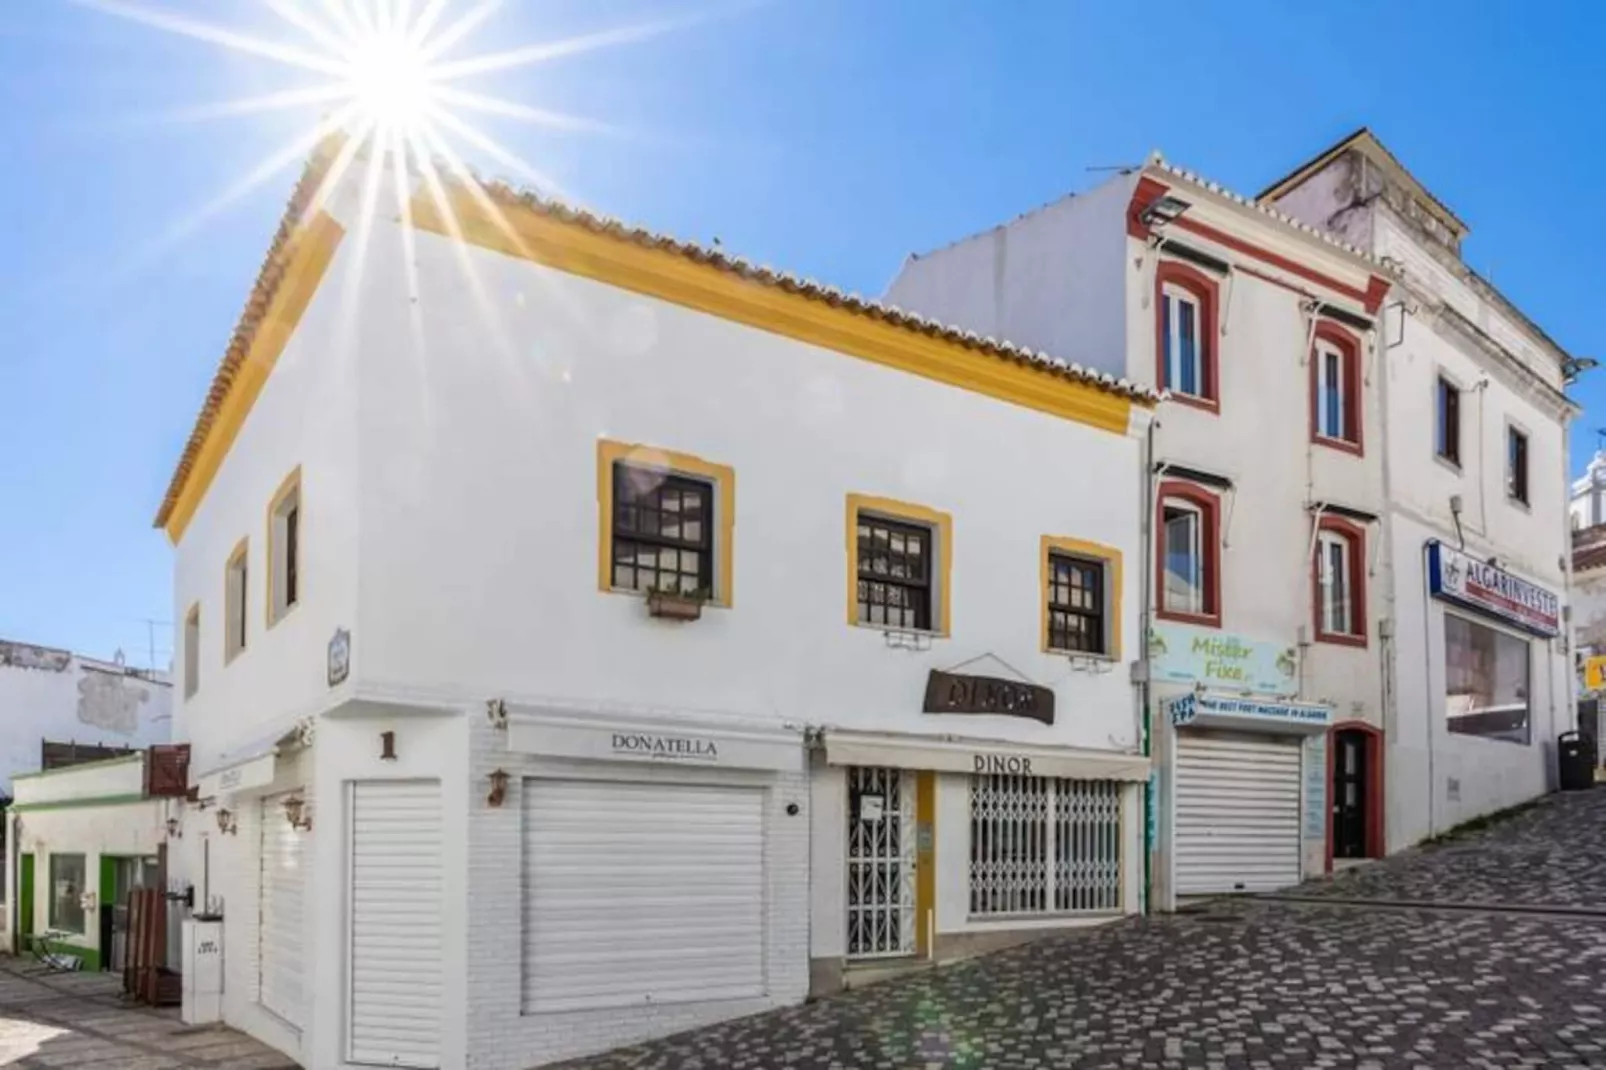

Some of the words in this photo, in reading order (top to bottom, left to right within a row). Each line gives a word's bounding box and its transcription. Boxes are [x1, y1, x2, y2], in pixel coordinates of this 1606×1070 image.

[1192, 637, 1253, 659] Mister
[1205, 660, 1243, 680] Fixe
[1219, 701, 1238, 713] BEST
[380, 731, 398, 761] 1
[611, 733, 718, 755] DONATELLA
[975, 755, 1033, 774] DINOR
